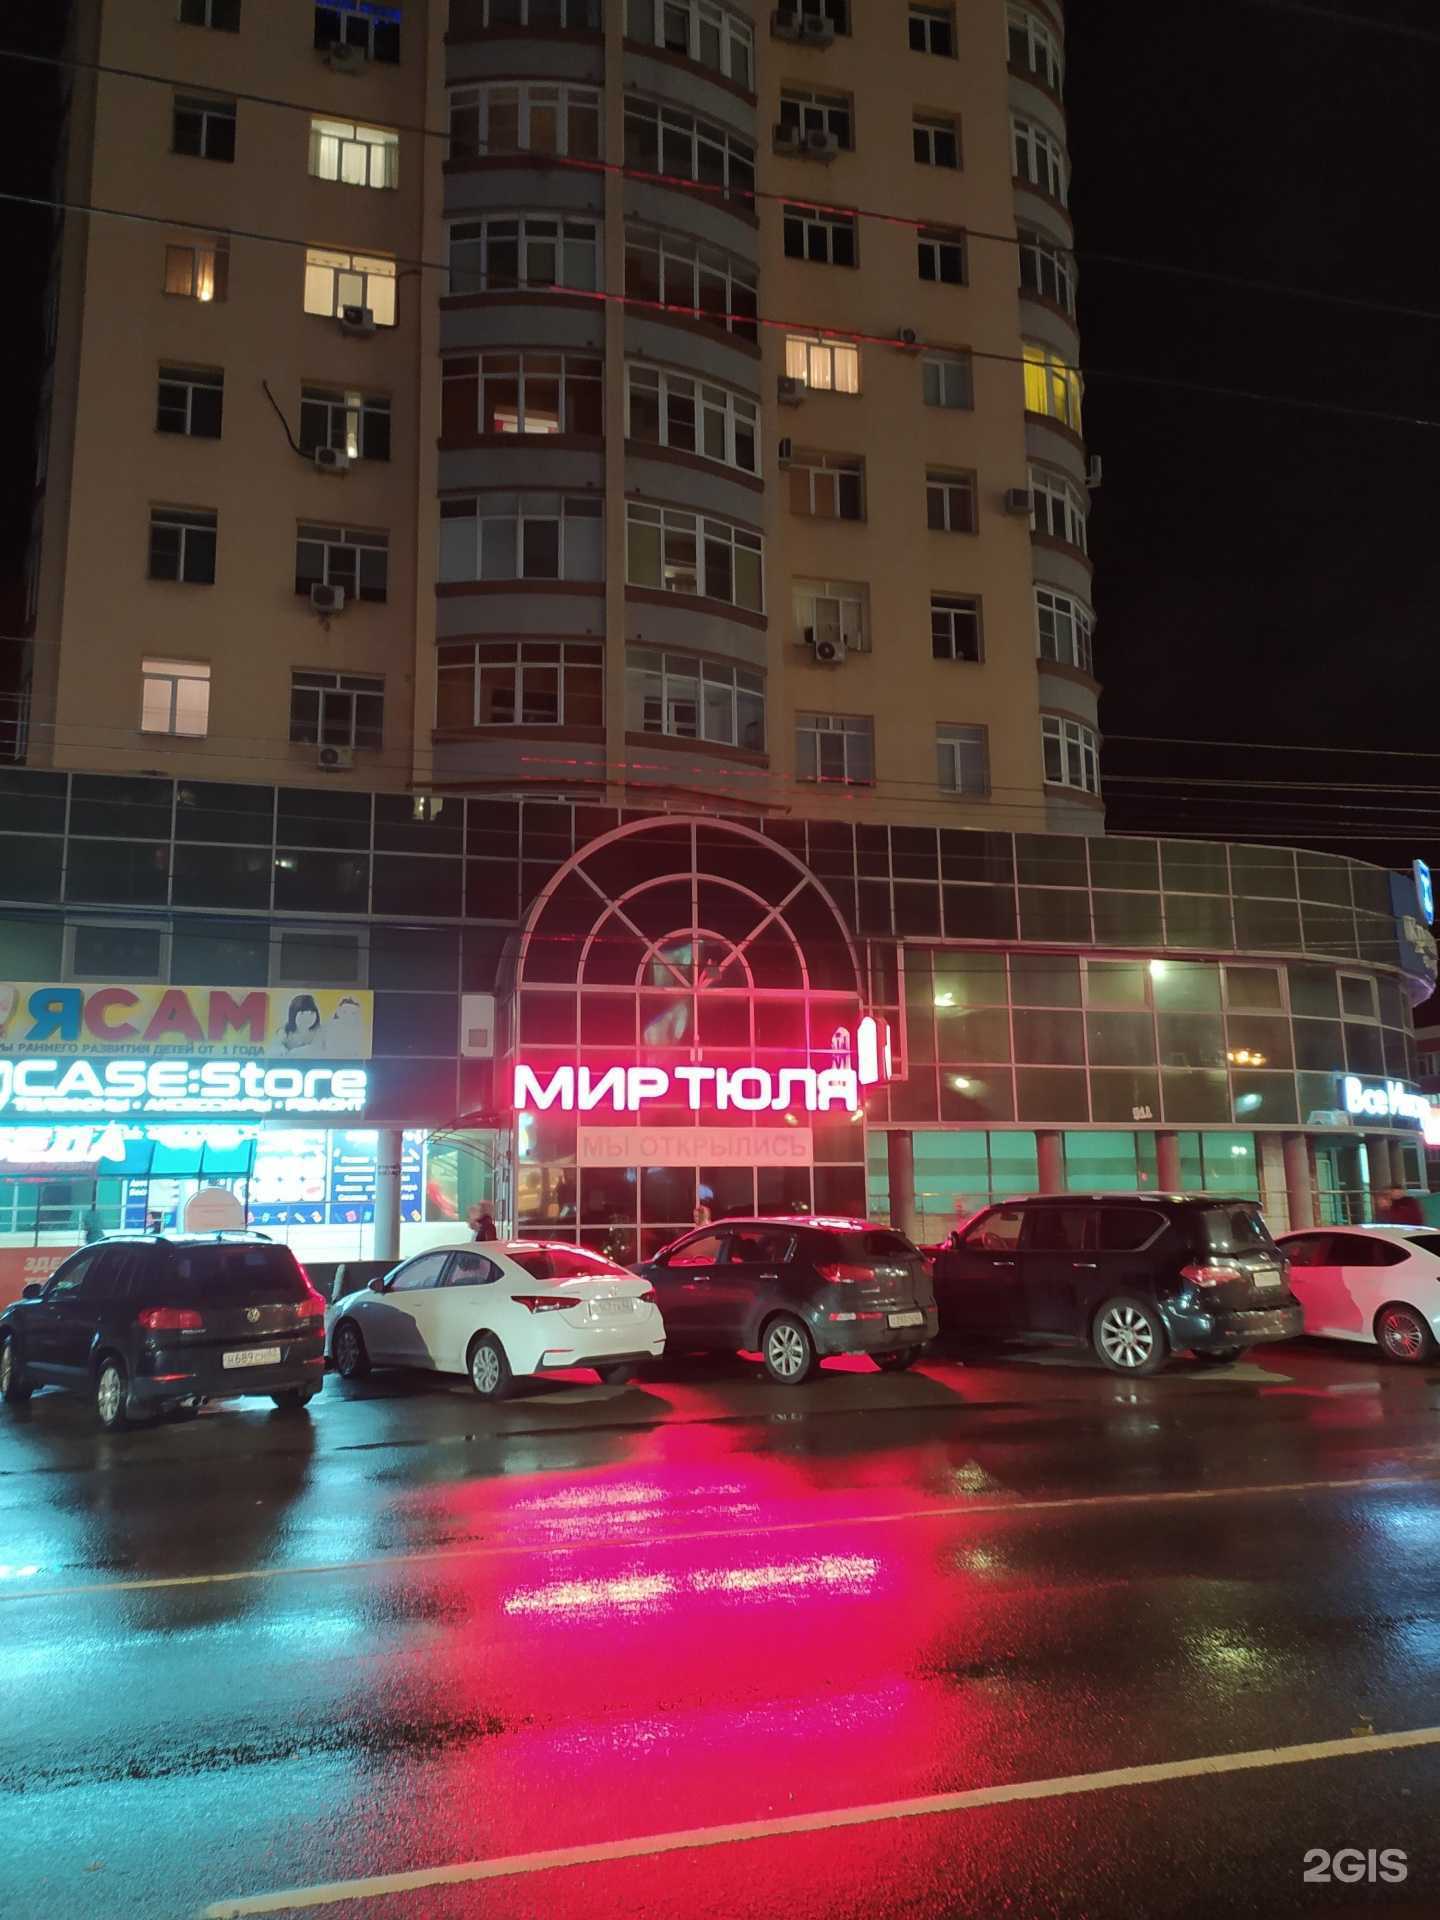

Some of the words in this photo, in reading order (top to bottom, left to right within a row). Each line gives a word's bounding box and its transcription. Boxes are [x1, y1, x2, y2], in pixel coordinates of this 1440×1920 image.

[18, 1042, 78, 1053] РАННЕГО
[154, 1041, 193, 1055] ДЕТЕЙ
[198, 1044, 215, 1054] ОТ
[233, 1044, 265, 1055] ГОДА
[514, 1065, 669, 1111] МИР
[674, 1066, 858, 1111] ТЮЛЯ
[583, 1135, 629, 1157] МЫ
[640, 1135, 807, 1158] ОТКРЫЛИСЬ
